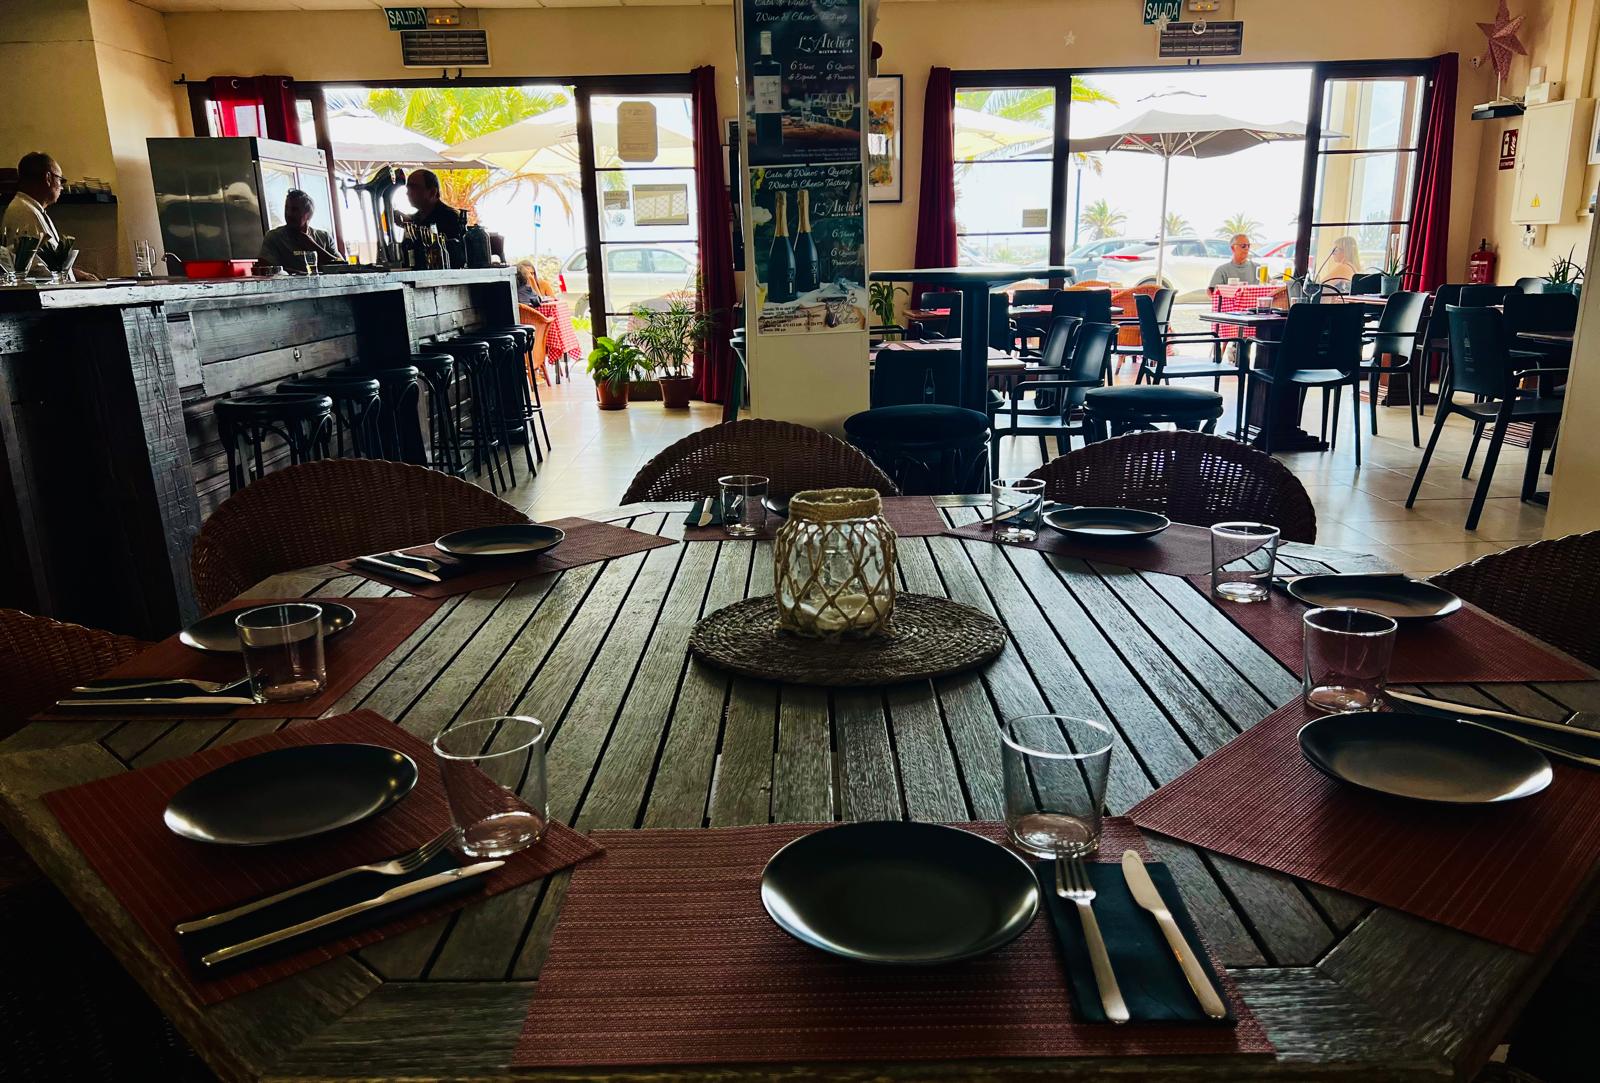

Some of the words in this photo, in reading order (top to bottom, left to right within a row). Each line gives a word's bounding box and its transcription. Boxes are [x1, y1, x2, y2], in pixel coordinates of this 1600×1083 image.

[1145, 2, 1179, 19] SALIDA
[388, 9, 425, 25] SALIDA
[755, 11, 779, 22] Wine
[790, 60, 798, 71] 6
[826, 60, 835, 71] 6
[765, 170, 784, 179] Cata
[768, 180, 790, 190] Wine
[799, 178, 824, 188] Cheese
[824, 178, 850, 190] Tasting
[831, 228, 839, 238] 6
[830, 247, 838, 257] 6
